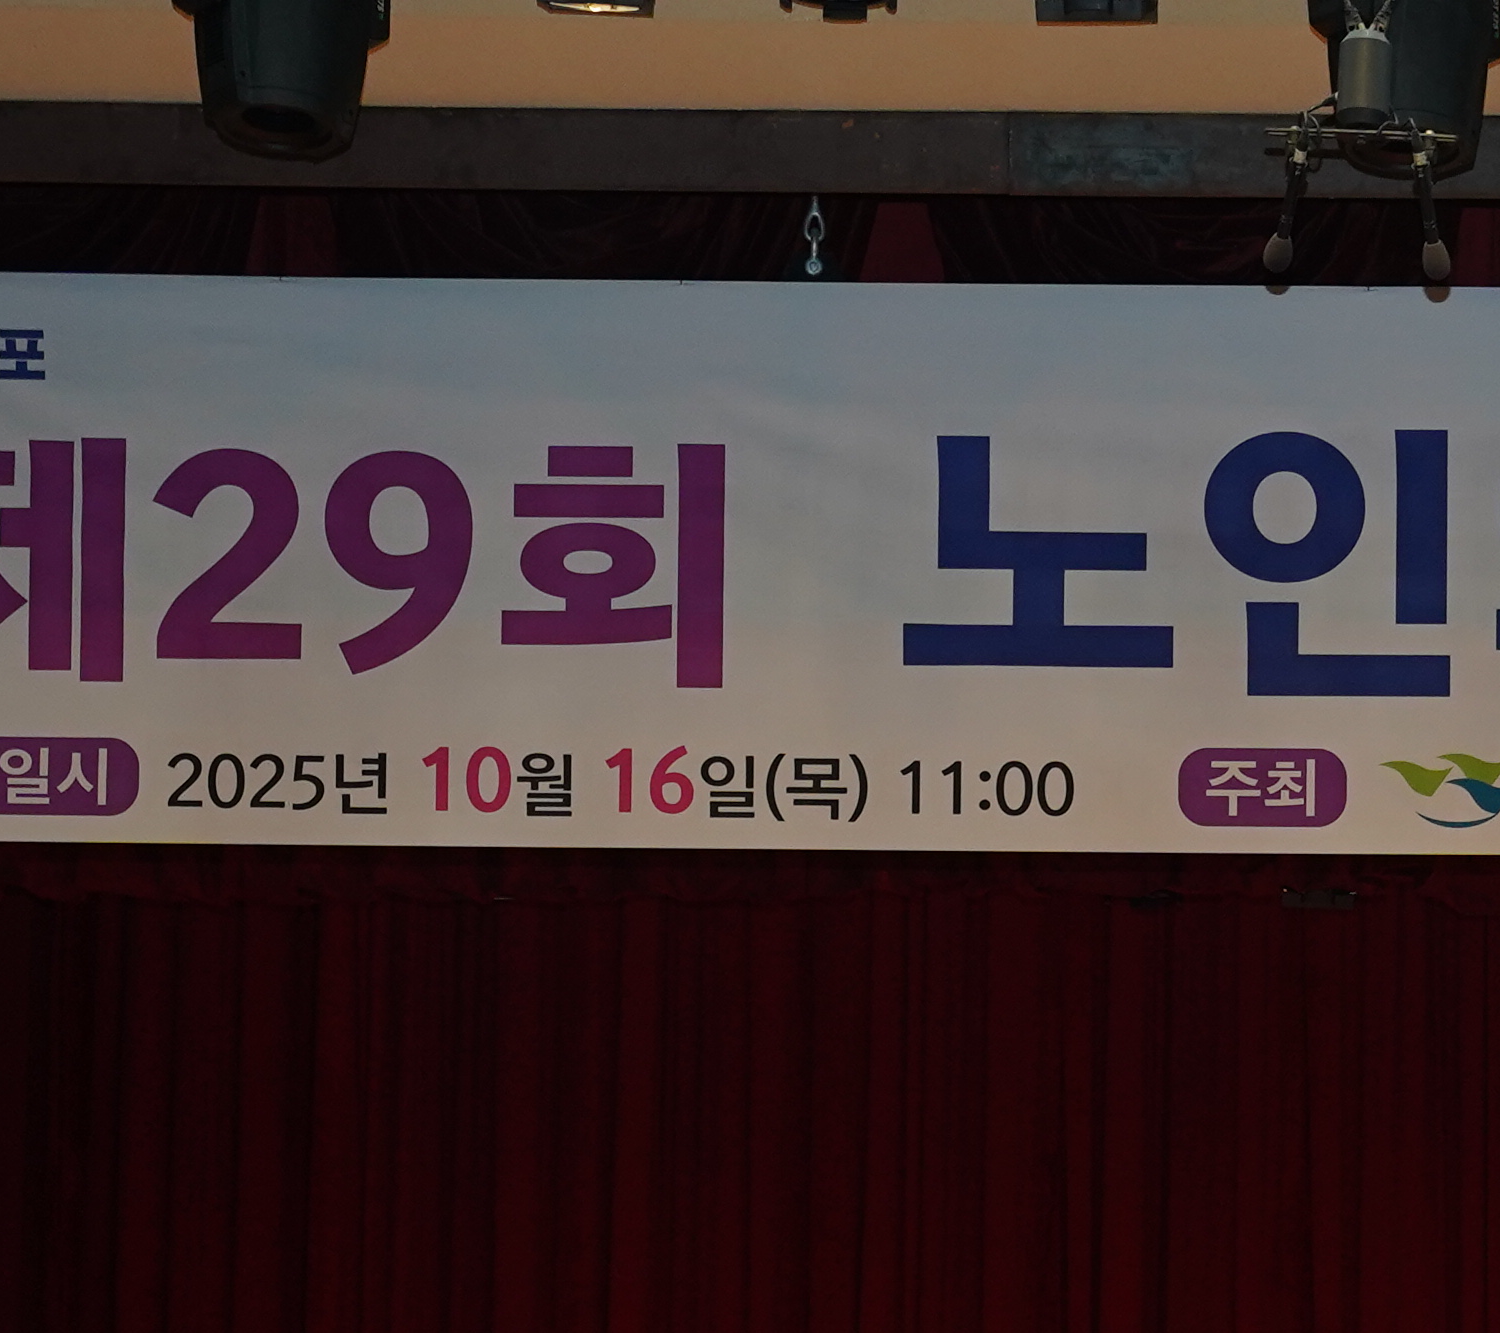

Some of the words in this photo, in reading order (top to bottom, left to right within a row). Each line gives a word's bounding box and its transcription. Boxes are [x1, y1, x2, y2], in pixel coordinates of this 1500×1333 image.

[0, 748, 107, 805] 일시
[168, 753, 387, 814] 2025년
[422, 747, 572, 816] 10월
[606, 746, 868, 822] 16일(목)
[901, 761, 1074, 816] 11:00
[1206, 759, 1315, 816] 주최
